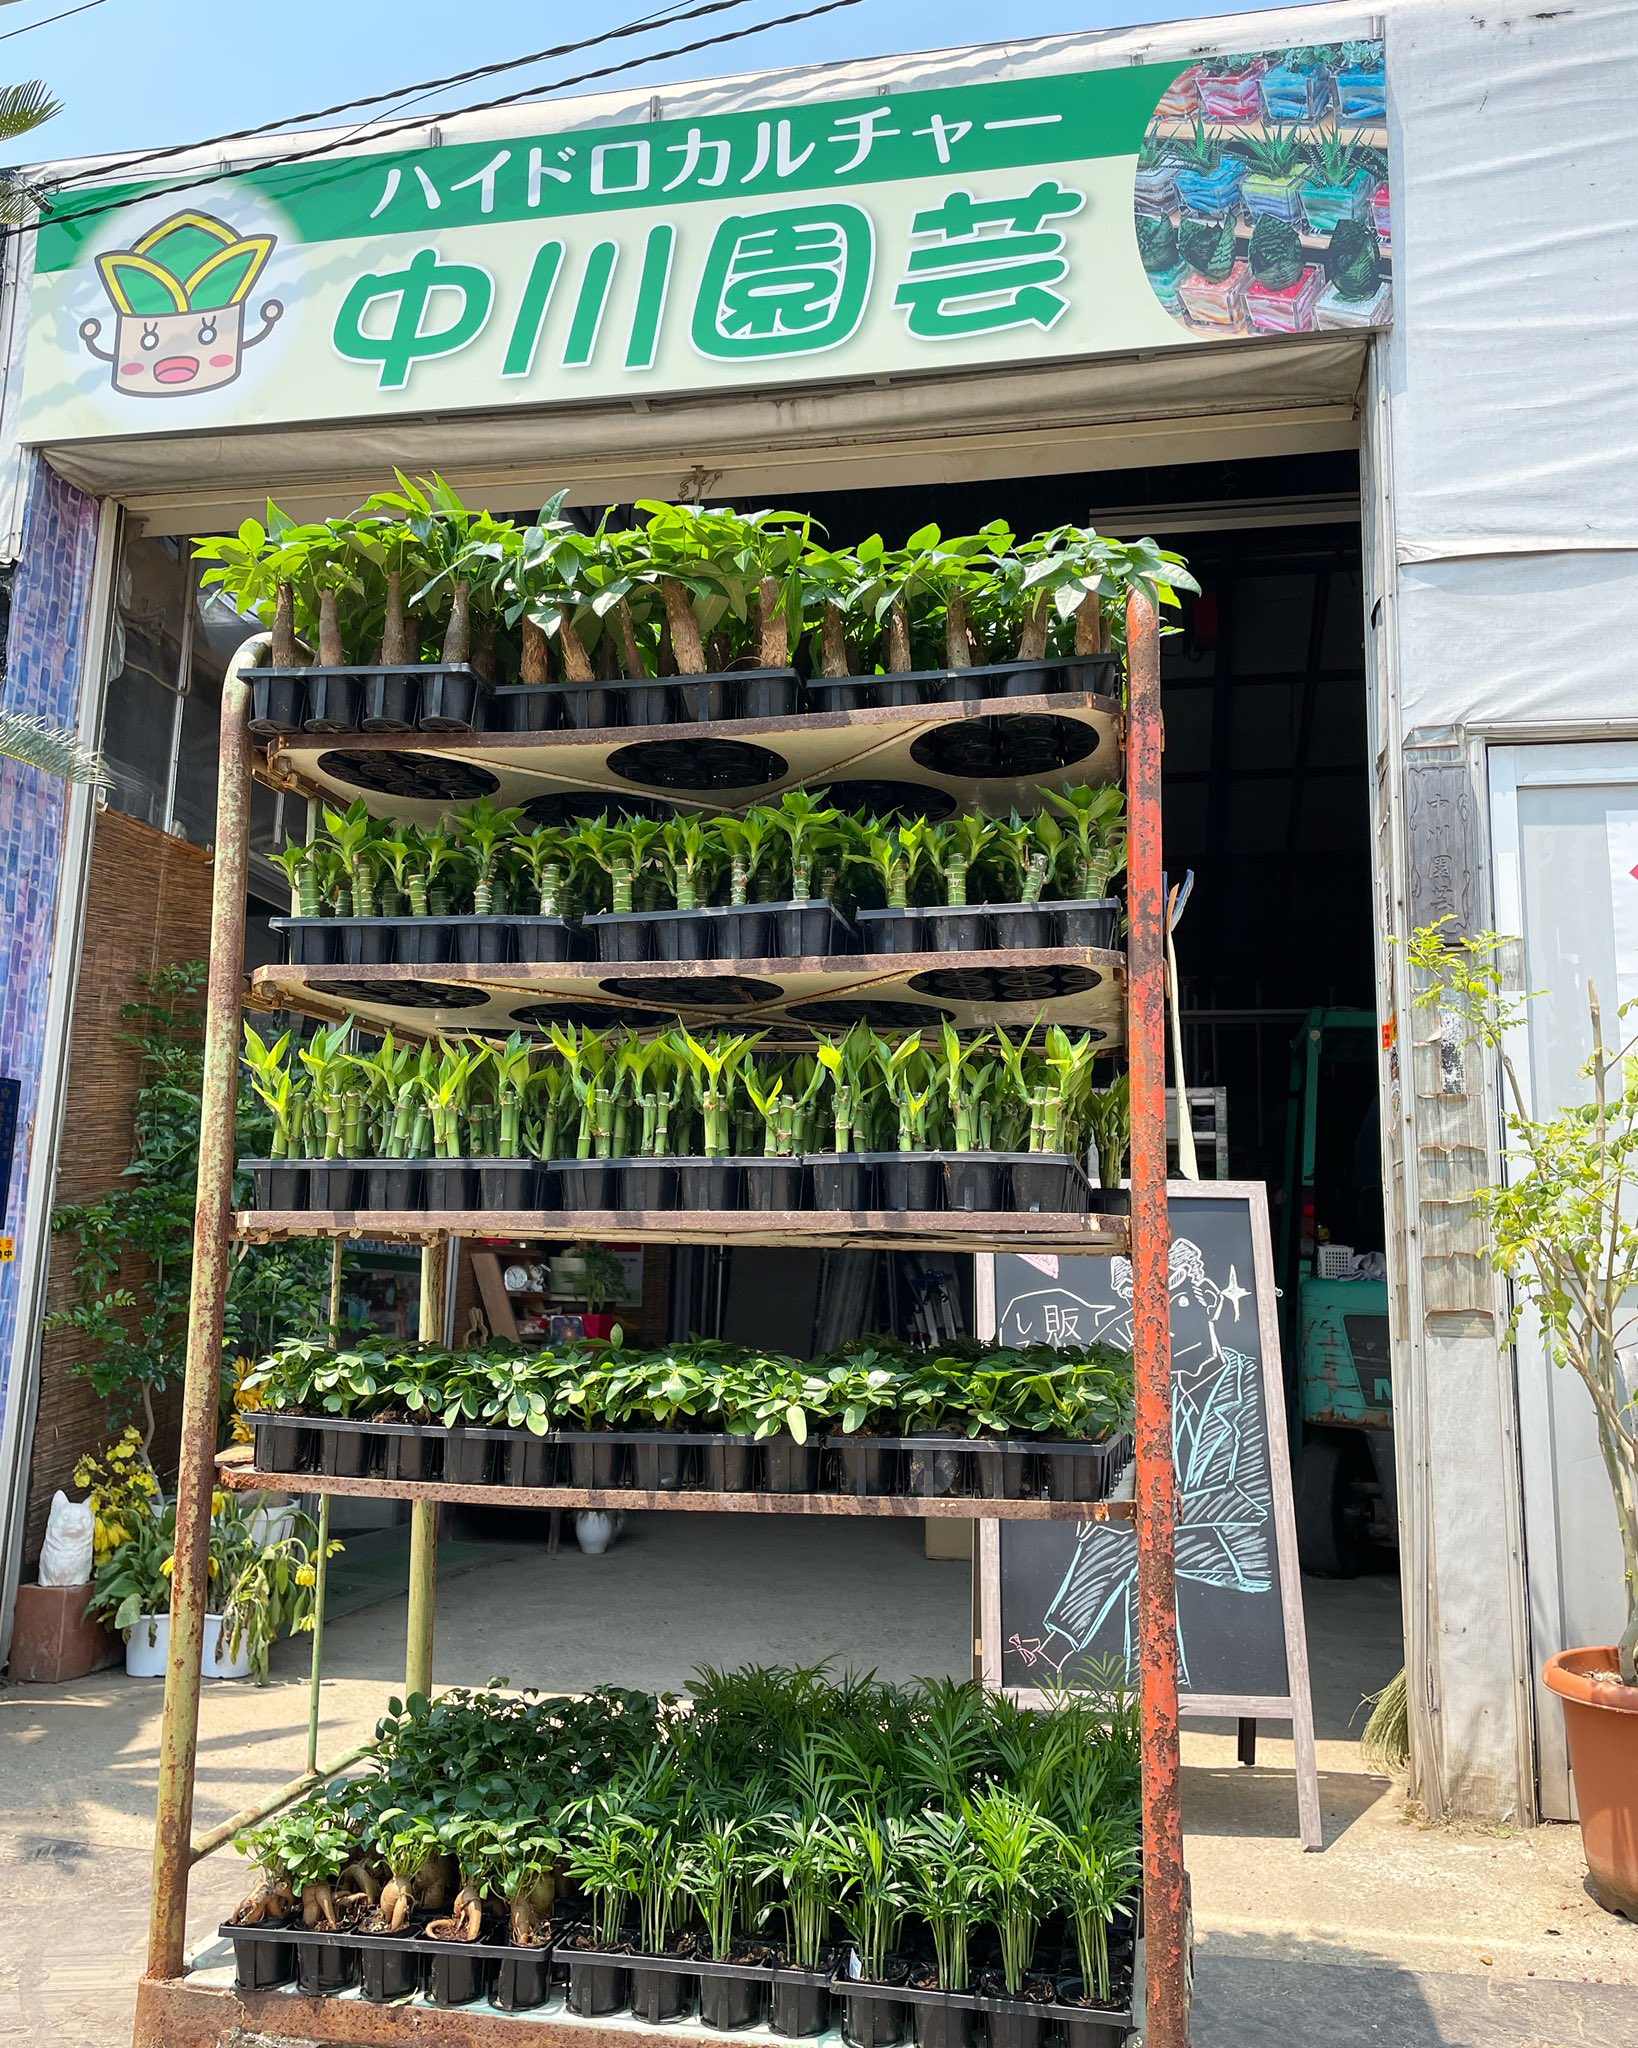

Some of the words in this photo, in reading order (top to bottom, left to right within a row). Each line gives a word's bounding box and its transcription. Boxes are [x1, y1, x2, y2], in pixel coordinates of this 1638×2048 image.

[369, 106, 1064, 219] ハイドロカルチャー
[332, 180, 1088, 391] 中川園芸
[1426, 792, 1455, 913] 中川園芸
